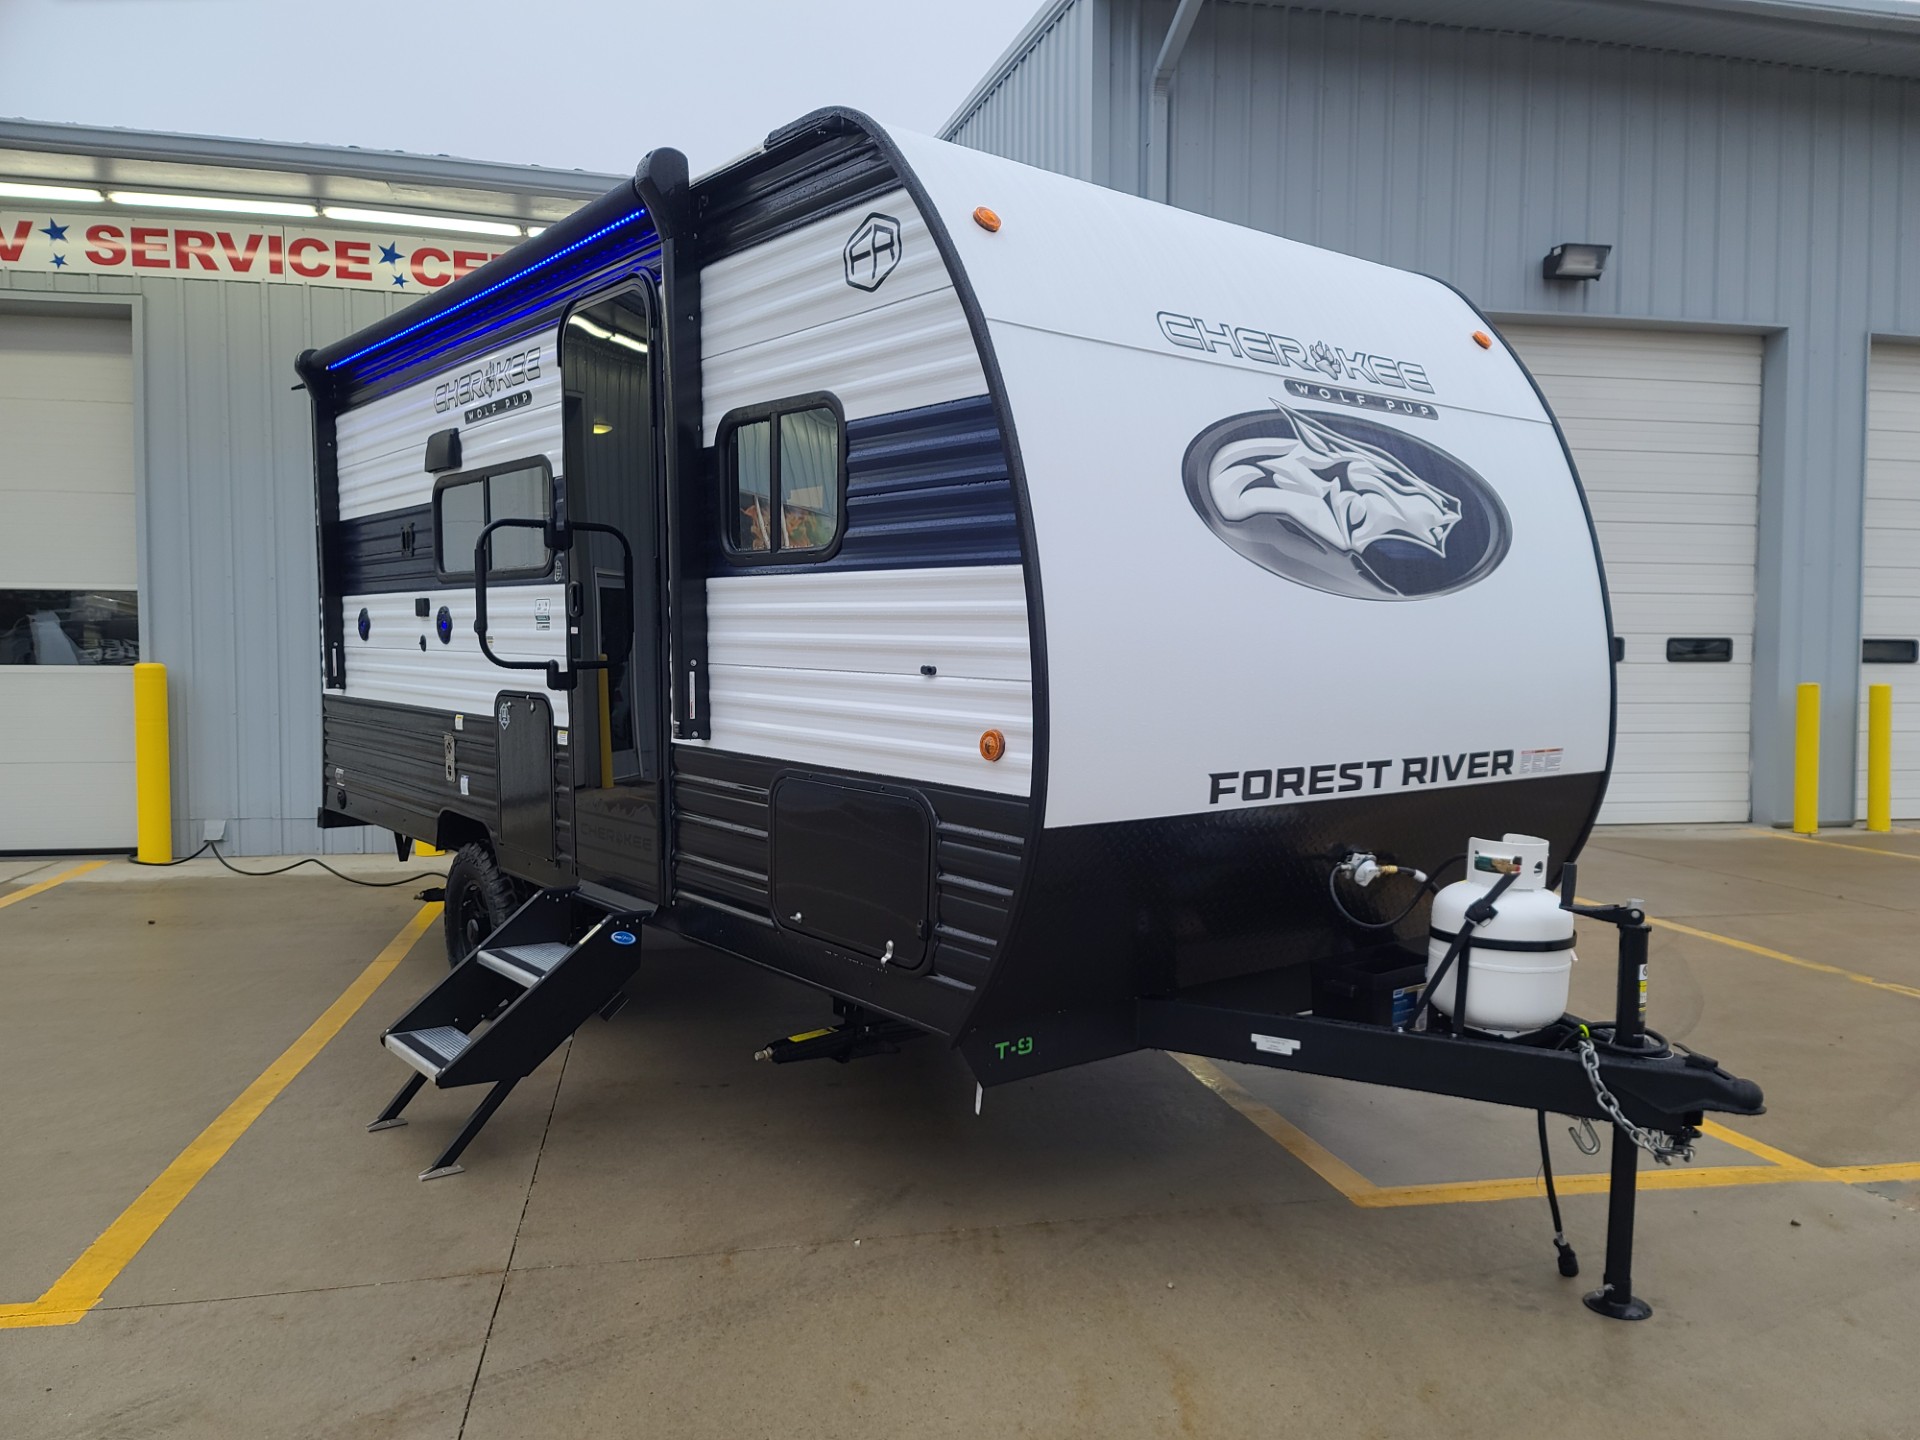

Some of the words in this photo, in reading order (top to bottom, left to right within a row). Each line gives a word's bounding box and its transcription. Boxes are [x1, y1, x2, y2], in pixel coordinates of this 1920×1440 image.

[85, 223, 373, 282] SERVICE
[410, 246, 505, 288] CE
[467, 402, 497, 420] WOLF
[505, 392, 529, 409] PUP
[1295, 383, 1367, 405] WOLF
[1385, 399, 1431, 416] PUP
[1208, 760, 1392, 805] FOREST
[1402, 749, 1514, 786] RIVER
